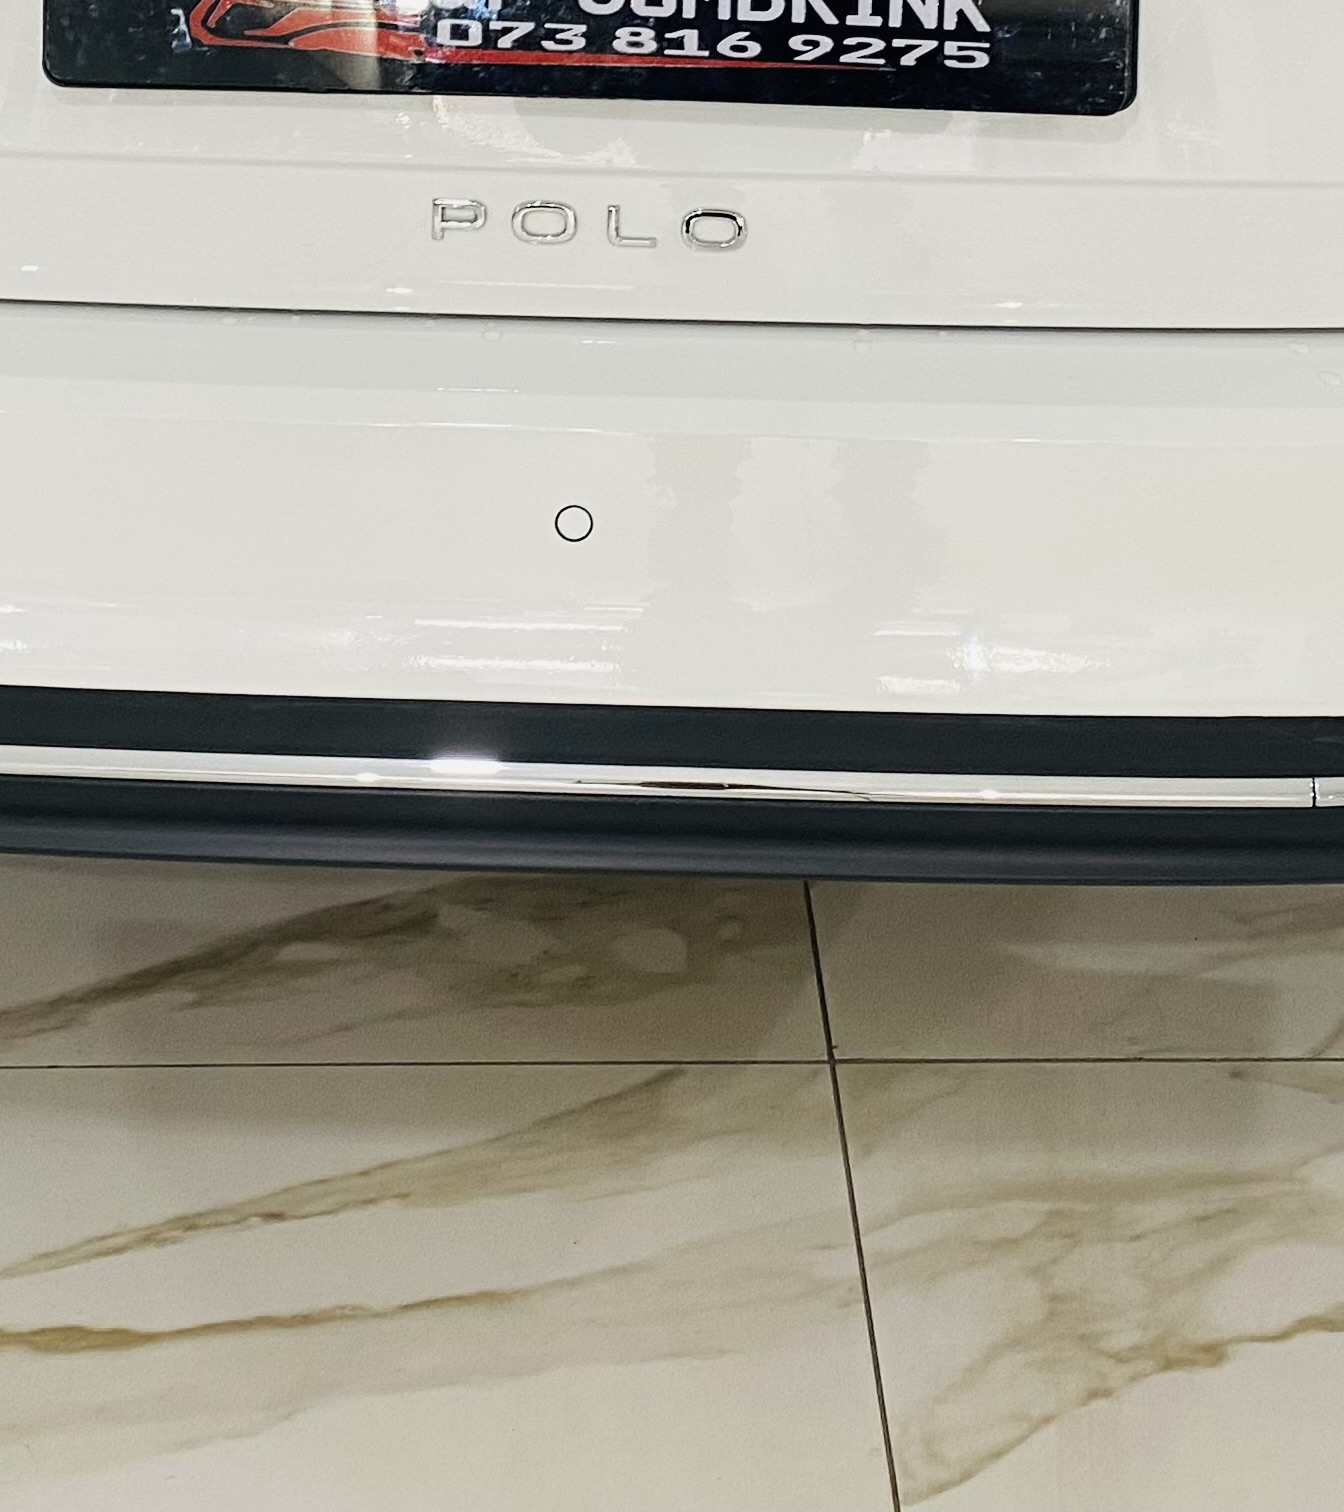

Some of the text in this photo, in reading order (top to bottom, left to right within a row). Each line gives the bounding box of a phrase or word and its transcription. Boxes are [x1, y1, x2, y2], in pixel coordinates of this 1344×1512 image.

[436, 18, 991, 69] 073 816 9275
[432, 197, 748, 251] POLO
